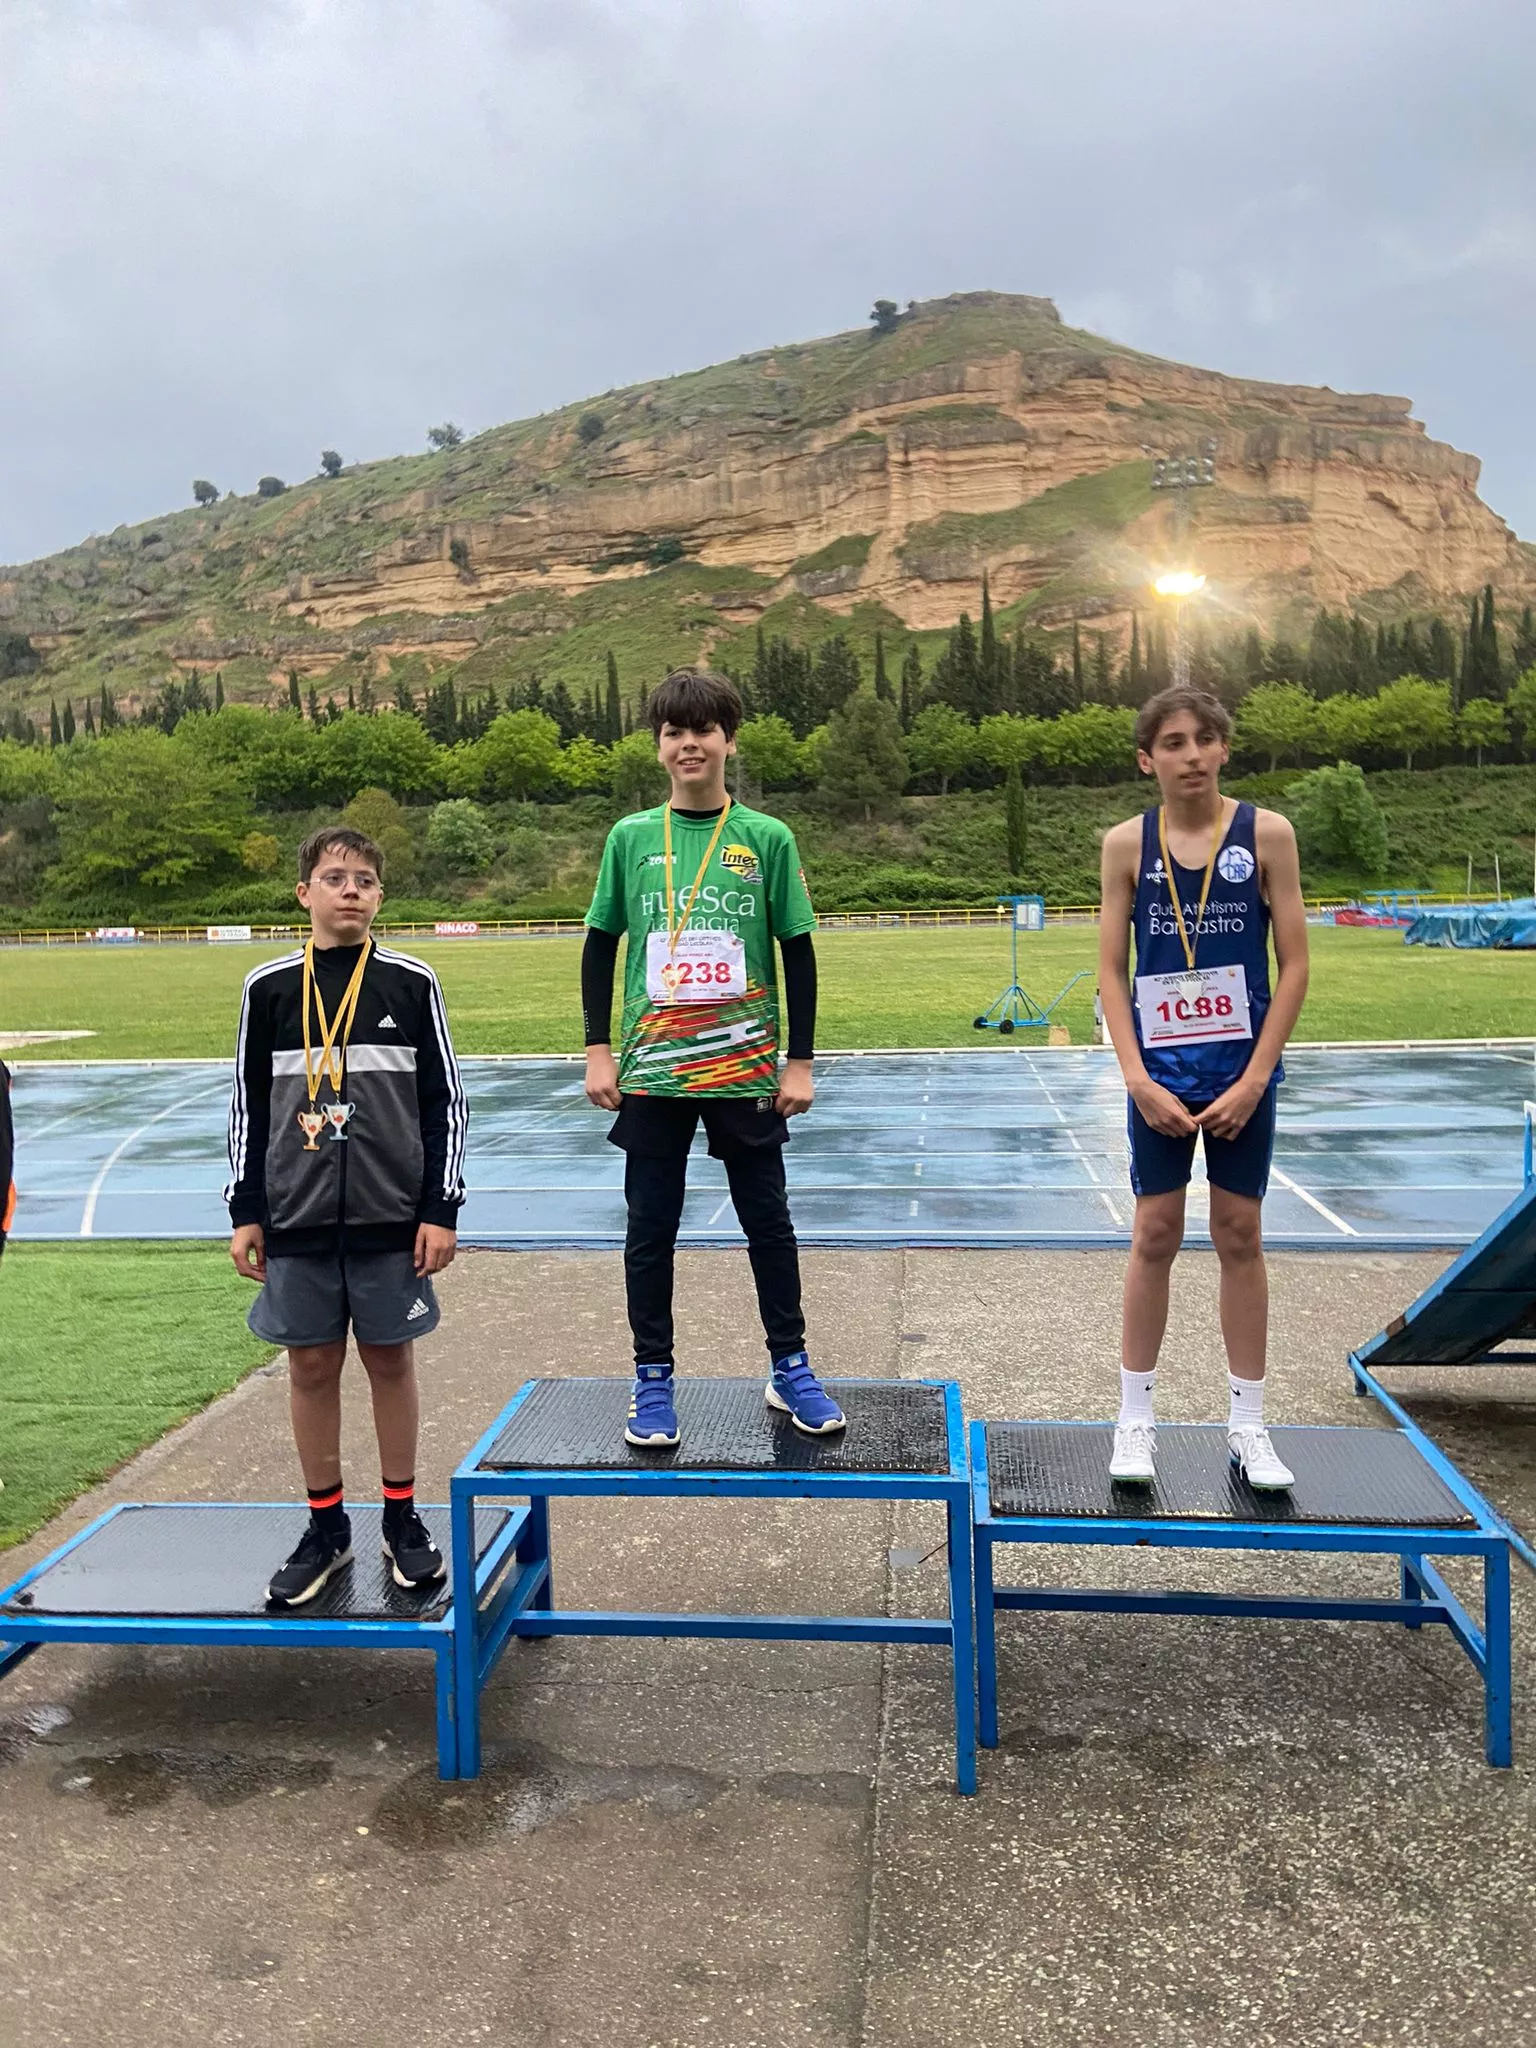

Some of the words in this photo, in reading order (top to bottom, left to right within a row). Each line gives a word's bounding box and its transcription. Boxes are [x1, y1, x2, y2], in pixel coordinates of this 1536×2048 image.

[723, 851, 759, 867] Intec
[1148, 902, 1177, 917] Club
[1157, 995, 1233, 1022] 1088
